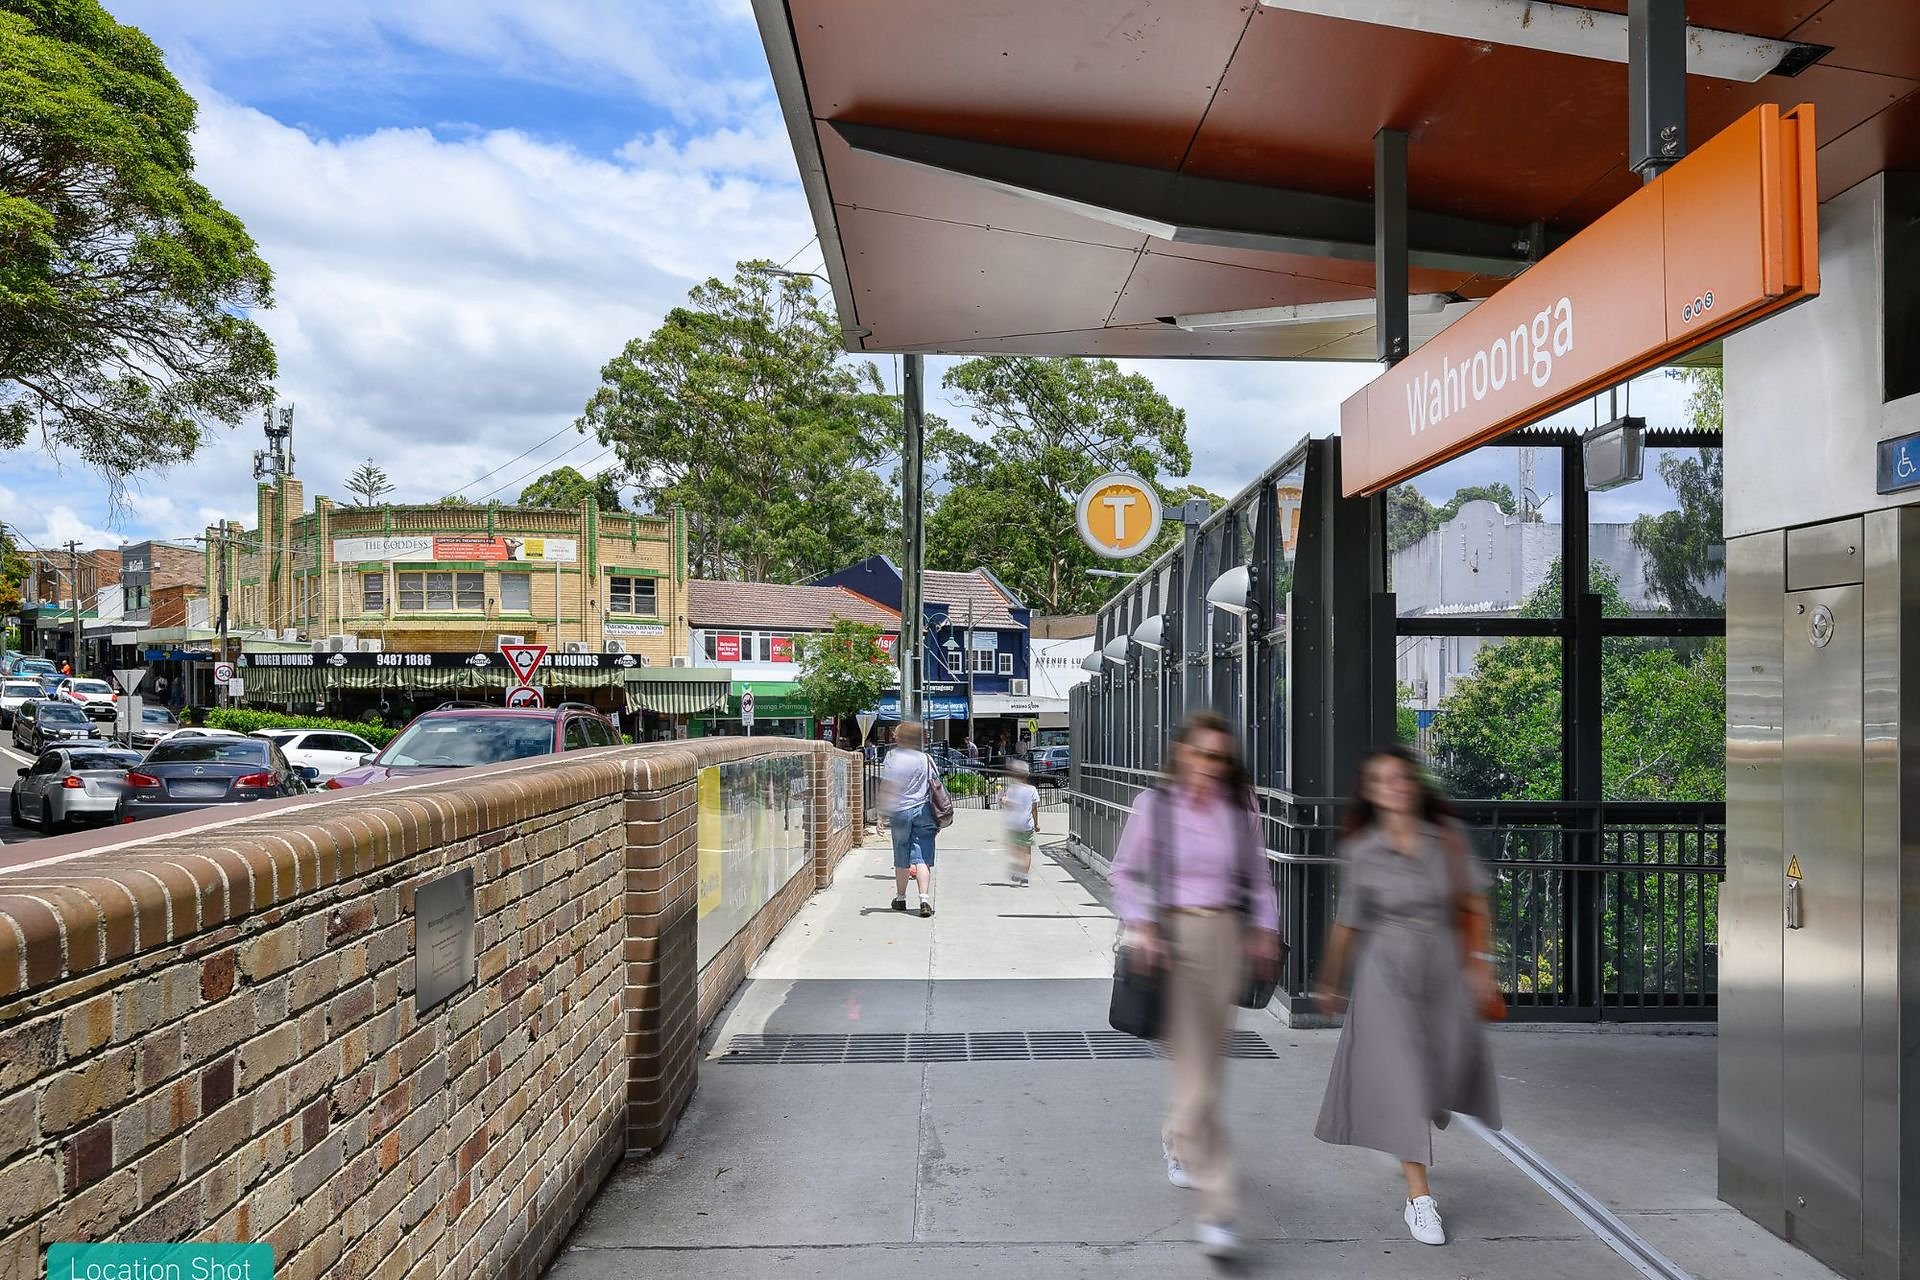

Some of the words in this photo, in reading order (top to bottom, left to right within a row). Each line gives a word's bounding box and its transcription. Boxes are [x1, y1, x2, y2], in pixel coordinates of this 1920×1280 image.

[1406, 296, 1573, 436] Wahroonga
[1103, 495, 1137, 541] T
[364, 541, 381, 550] THE
[383, 540, 429, 550] GODDESS
[254, 654, 280, 666] BURGER
[281, 654, 314, 666] HOUNDS
[376, 653, 402, 666] 9487
[404, 654, 432, 666] 1886
[554, 654, 599, 666] HOUNDS
[1035, 657, 1068, 665] AVENUE
[218, 669, 231, 678] 50
[779, 703, 807, 711] Pharmacy
